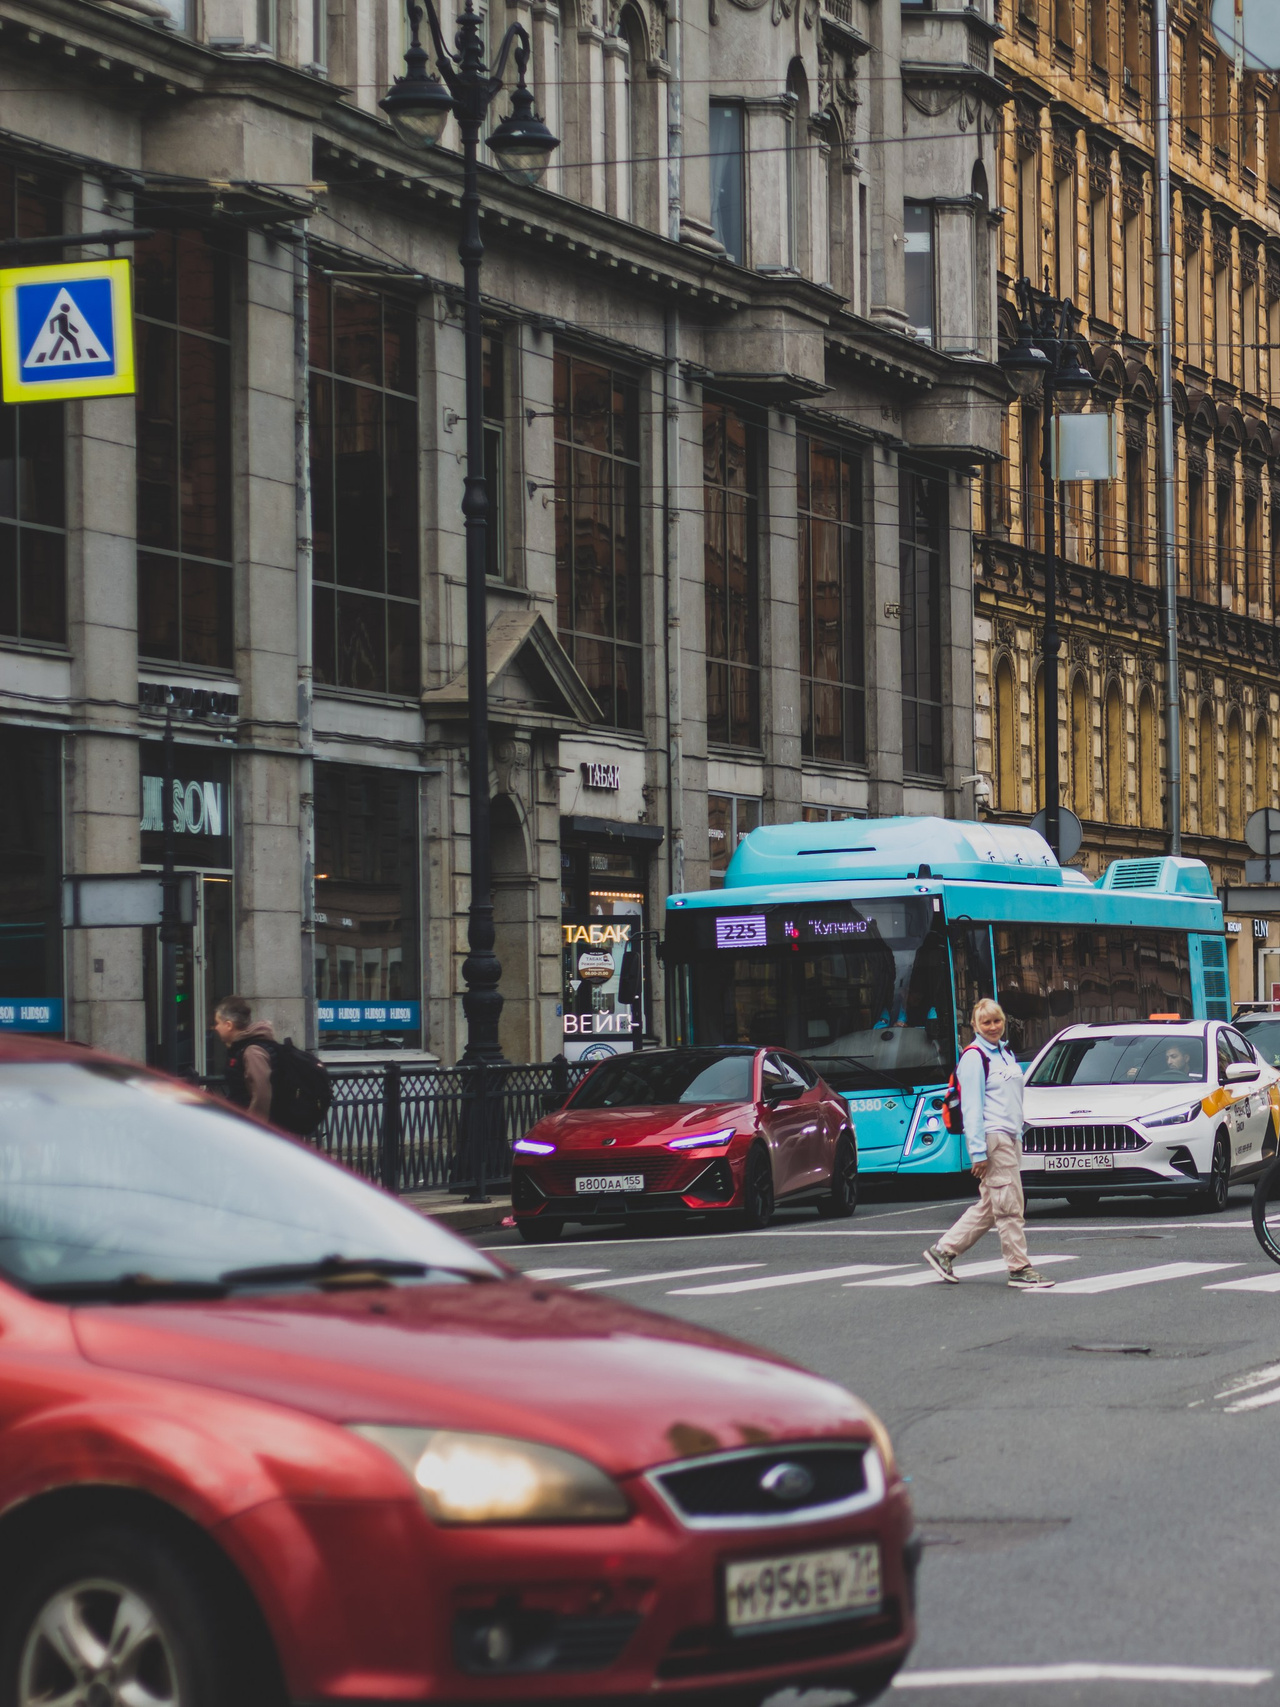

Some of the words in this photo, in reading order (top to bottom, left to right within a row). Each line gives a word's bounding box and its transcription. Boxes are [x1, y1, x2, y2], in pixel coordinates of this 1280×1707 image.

[586, 762, 620, 790] ТАБАК
[562, 924, 630, 944] ТАБАК
[724, 924, 757, 940] 225
[1254, 919, 1269, 937] ELNY
[850, 1099, 882, 1112] 8380
[1048, 1156, 1092, 1169] Н307СЕ
[1094, 1155, 1110, 1164] 126
[579, 1178, 622, 1190] В800АА
[624, 1176, 641, 1185] 155
